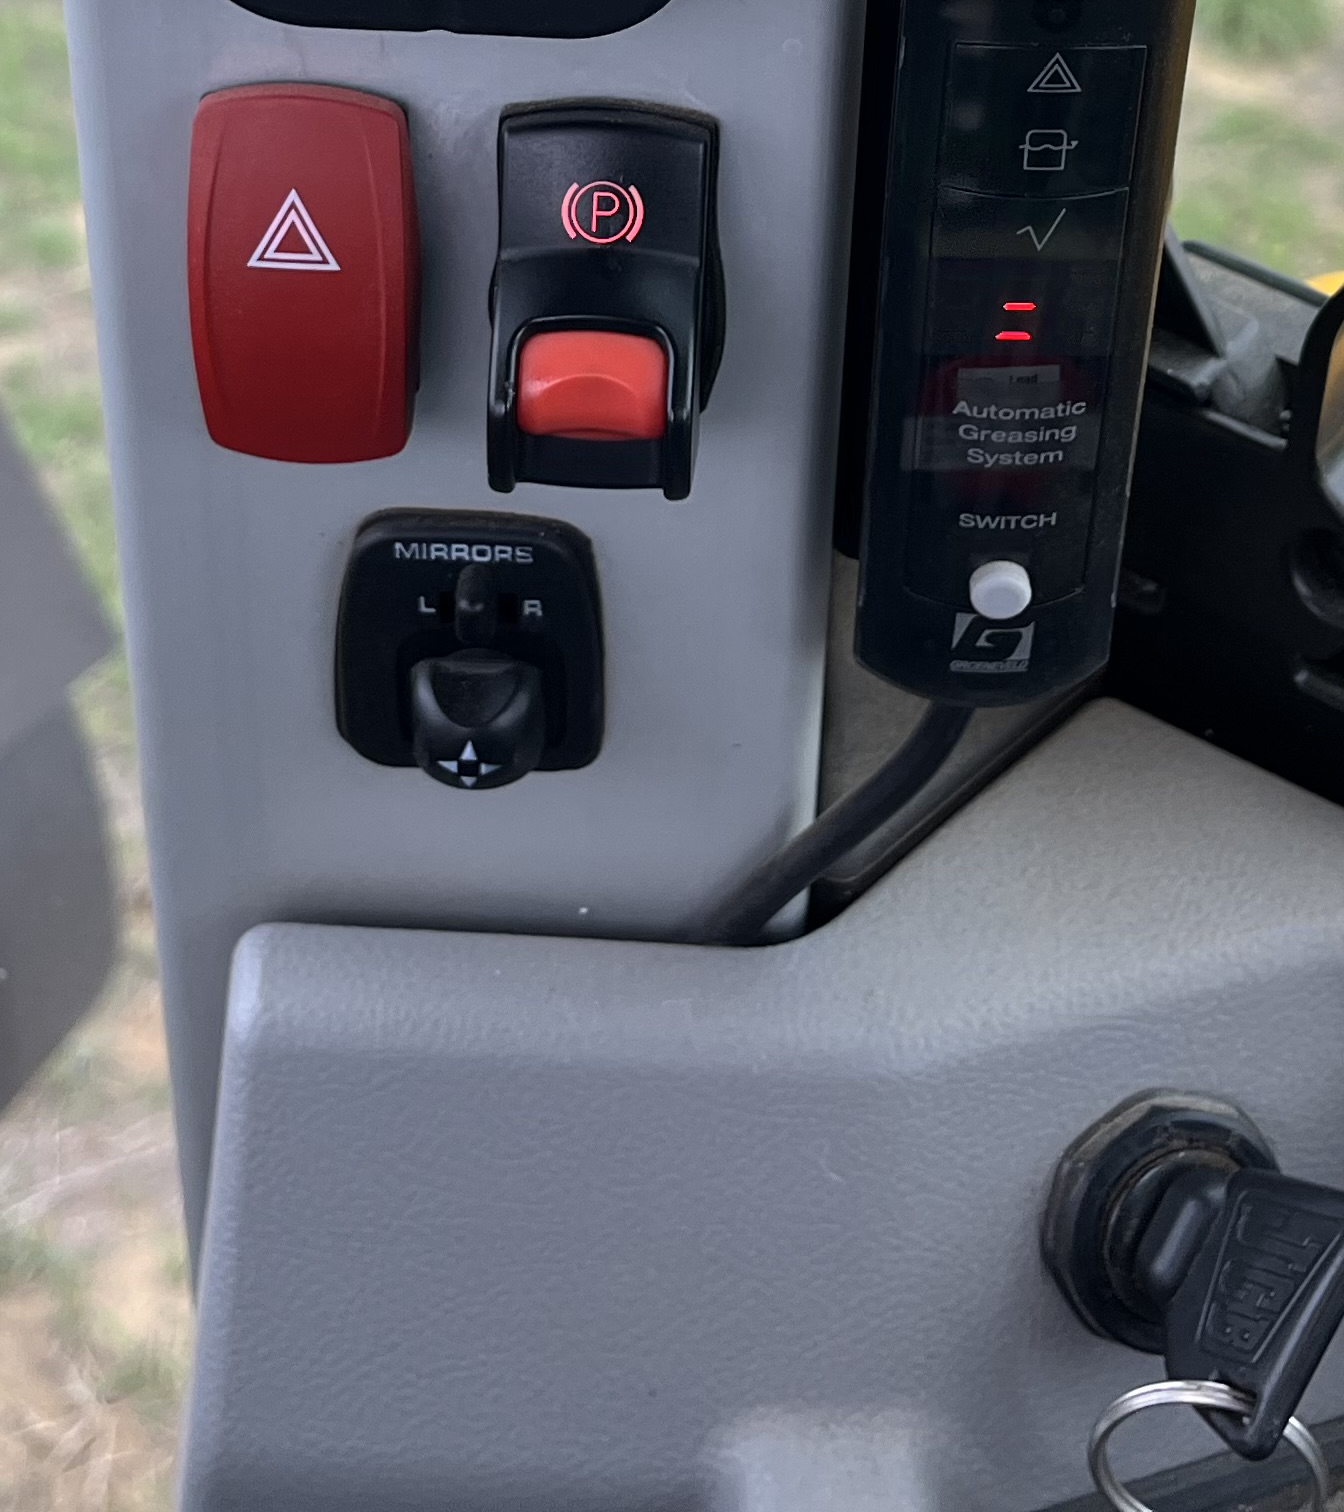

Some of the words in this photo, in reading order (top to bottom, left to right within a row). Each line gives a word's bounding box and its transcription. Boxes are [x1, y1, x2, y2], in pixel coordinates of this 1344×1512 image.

[591, 191, 620, 232] P
[952, 400, 1087, 420] Automatic
[958, 424, 1077, 442] Greasing
[966, 448, 1063, 468] System
[959, 512, 1057, 529] SWITCH
[394, 541, 534, 563] MIRRORS
[419, 596, 436, 613] L
[524, 600, 543, 616] R
